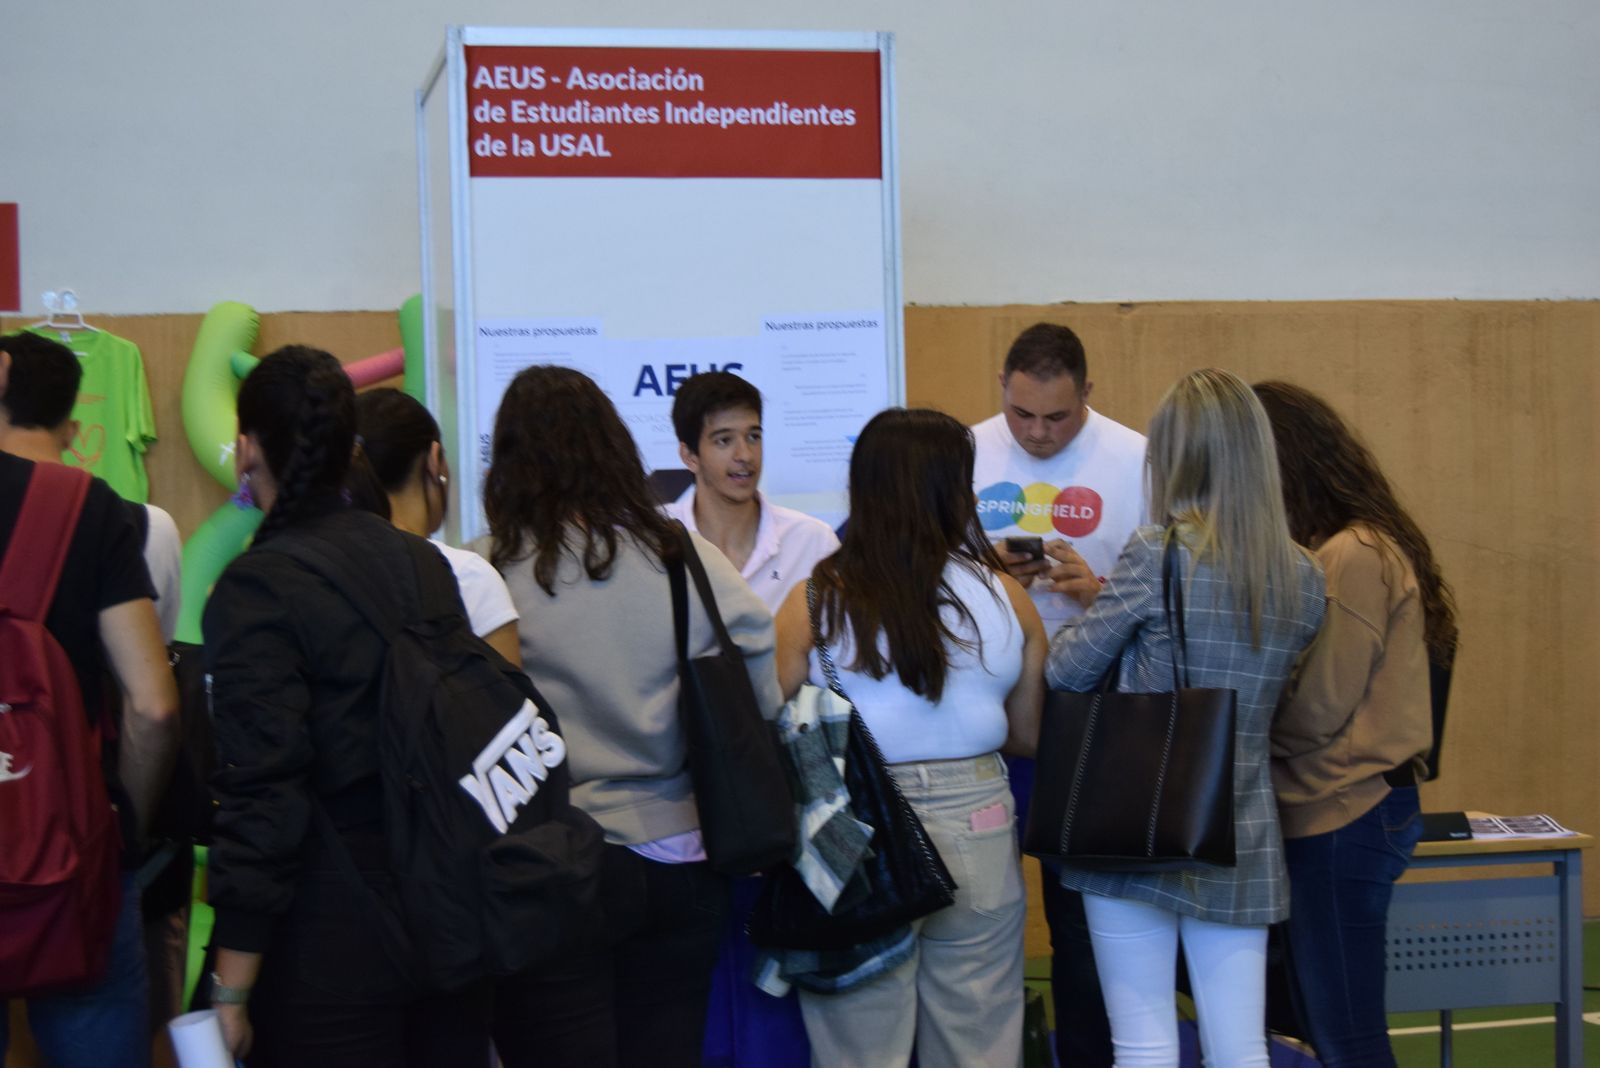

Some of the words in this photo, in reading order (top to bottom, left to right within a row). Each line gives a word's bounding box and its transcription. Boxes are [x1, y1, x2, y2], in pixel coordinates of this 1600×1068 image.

[472, 66, 547, 90] AEUS
[566, 66, 705, 92] Asociación
[473, 99, 506, 124] de
[511, 99, 661, 125] Estudiantes
[665, 101, 857, 129] Independientes
[474, 132, 506, 157] de
[512, 133, 535, 157] la
[540, 133, 612, 158] USAL
[479, 327, 531, 337] Nuestras
[533, 326, 598, 338] propuestas
[764, 321, 814, 332] Nuestras
[816, 319, 879, 332] propuestas
[976, 499, 1095, 520] SPRINGFIELD
[459, 697, 566, 835] VANS
